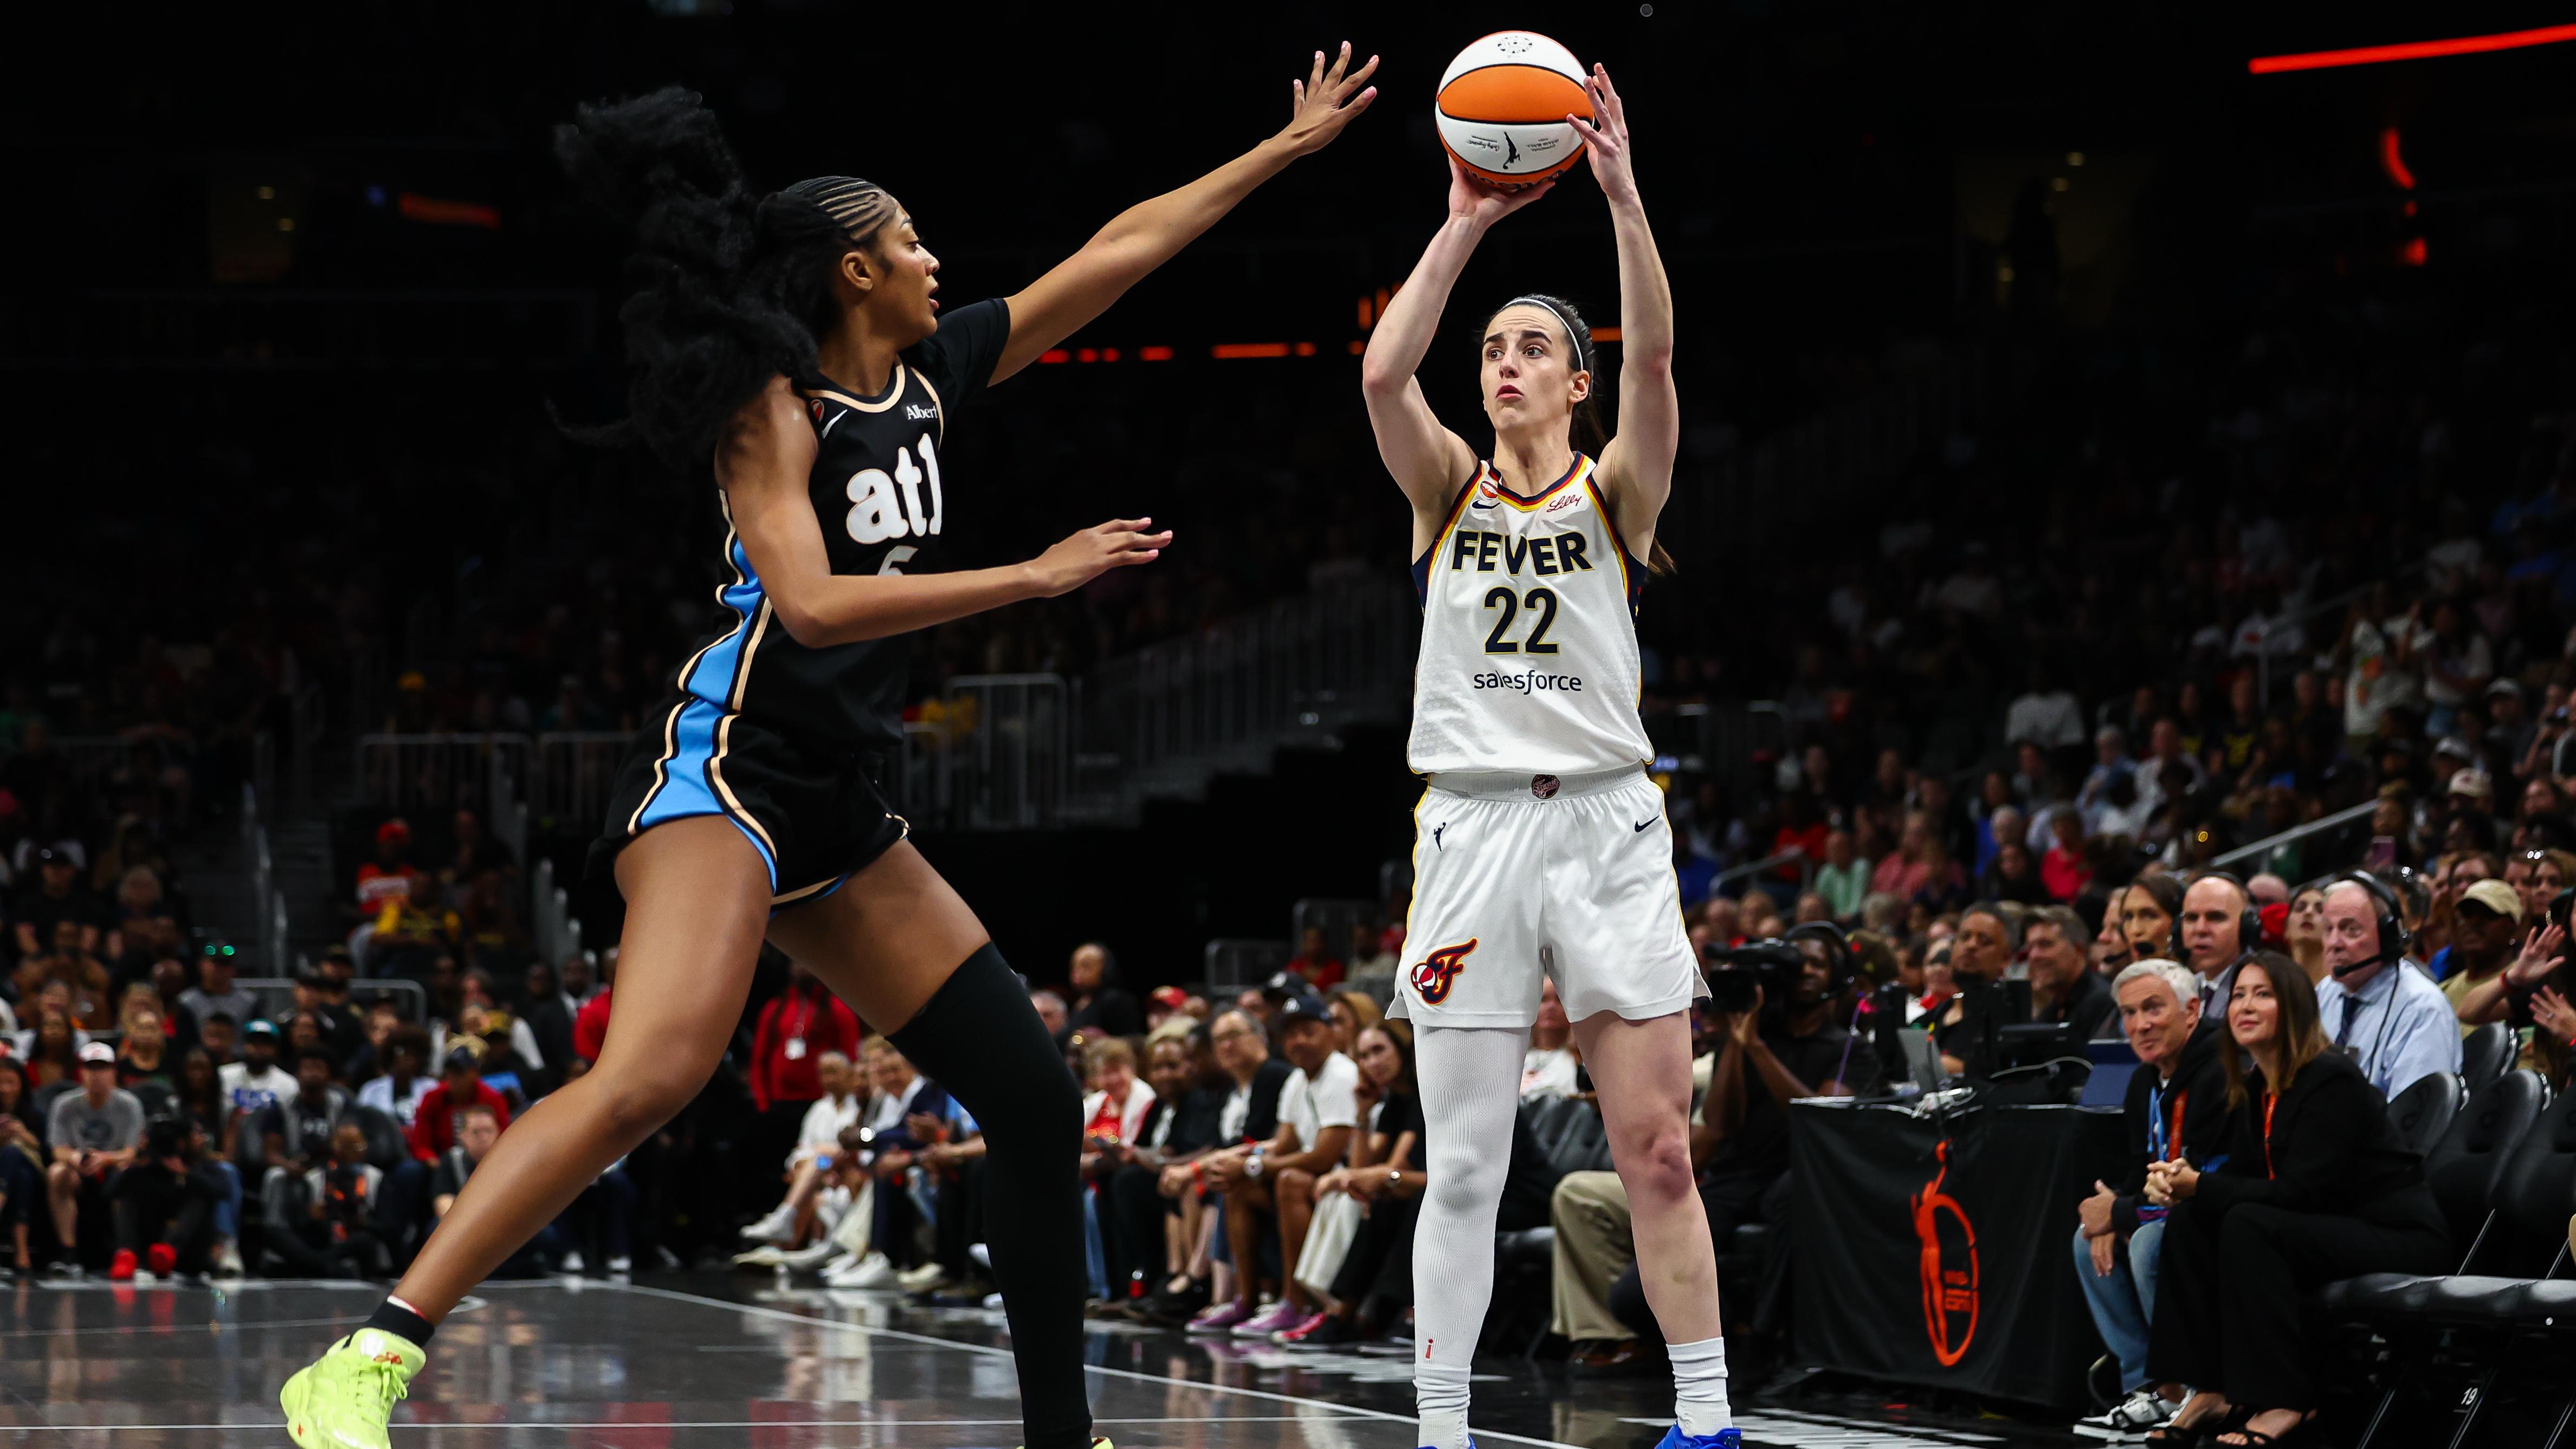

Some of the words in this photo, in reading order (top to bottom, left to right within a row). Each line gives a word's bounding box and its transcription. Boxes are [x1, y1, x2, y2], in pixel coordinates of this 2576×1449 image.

[906, 404, 938, 420] Albert
[846, 432, 942, 544] atl
[1546, 494, 1582, 512] Lilly
[1450, 529, 1596, 576] FEVER
[1483, 586, 1559, 655] 22
[1473, 669, 1582, 695] salesforce
[2461, 1387, 2478, 1405] 19
